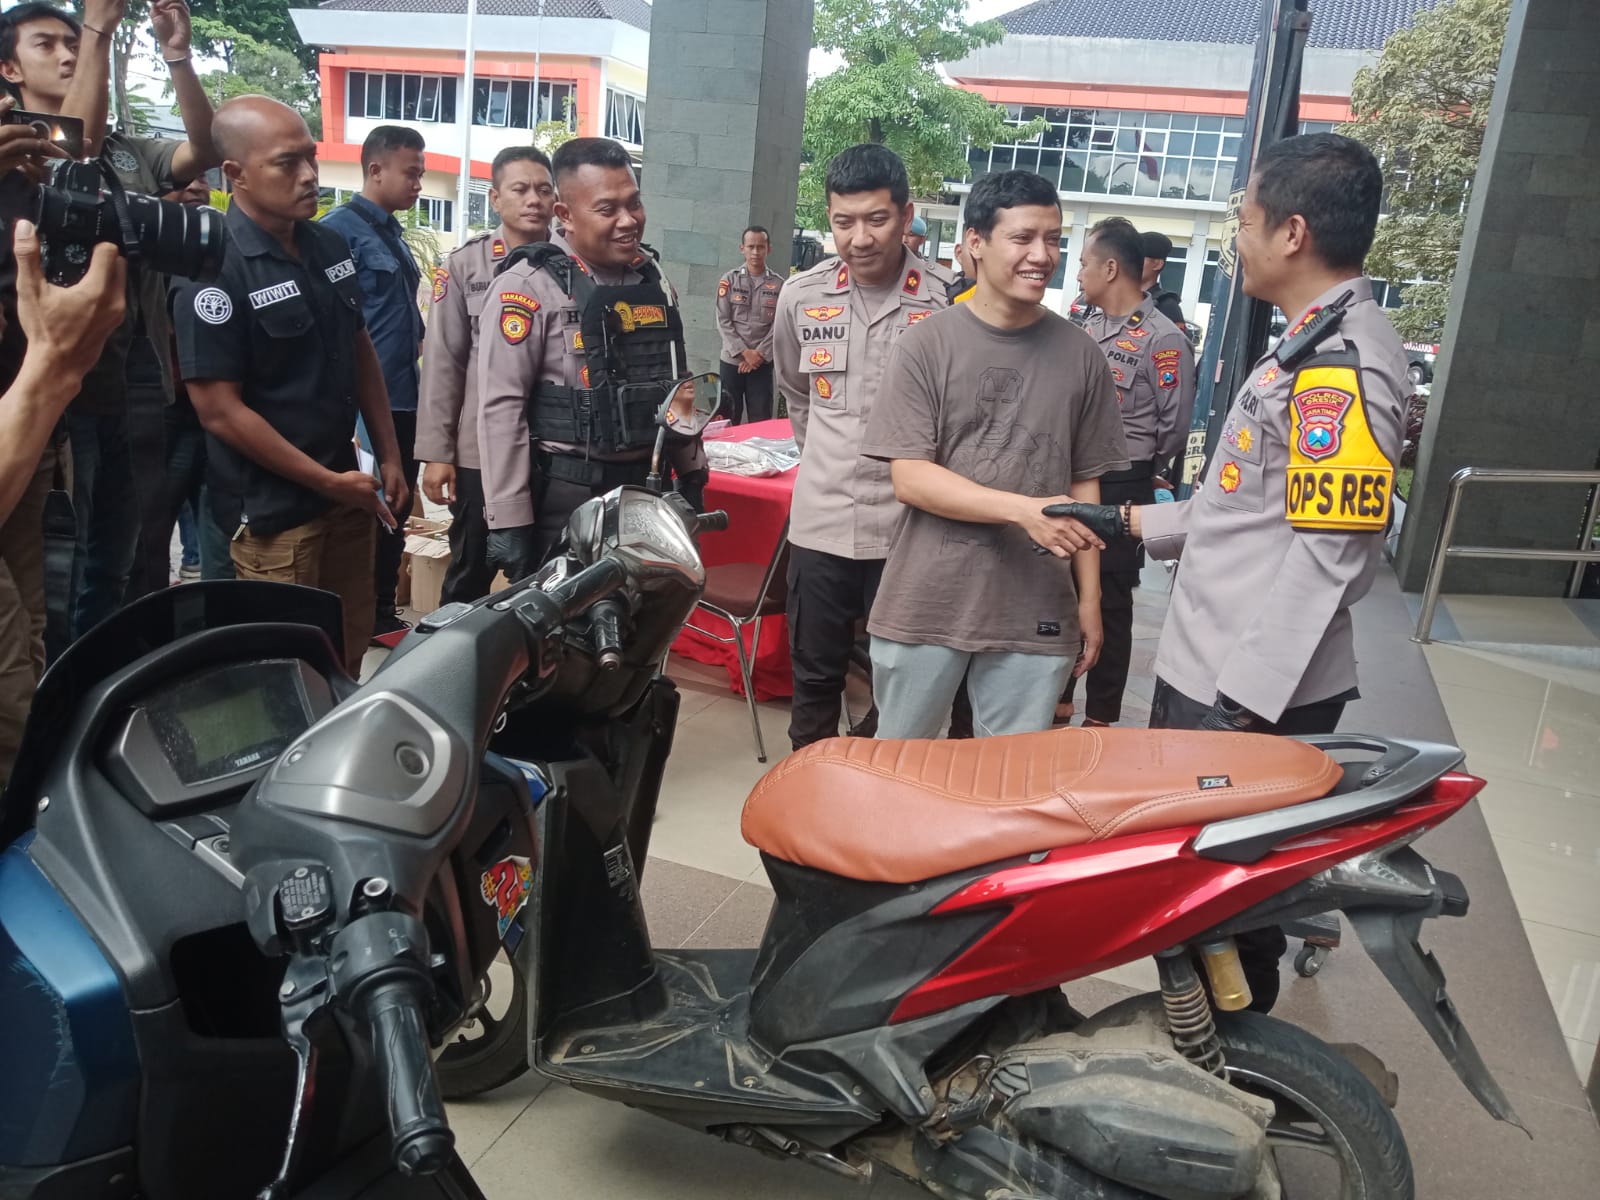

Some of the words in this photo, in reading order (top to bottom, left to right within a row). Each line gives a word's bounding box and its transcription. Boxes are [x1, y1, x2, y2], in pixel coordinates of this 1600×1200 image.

[253, 283, 297, 305] WIWIT
[802, 326, 845, 341] DANU
[1106, 350, 1138, 367] POLRI
[1302, 393, 1345, 403] POLRES
[1289, 472, 1334, 515] OPS
[1340, 473, 1386, 517] RES
